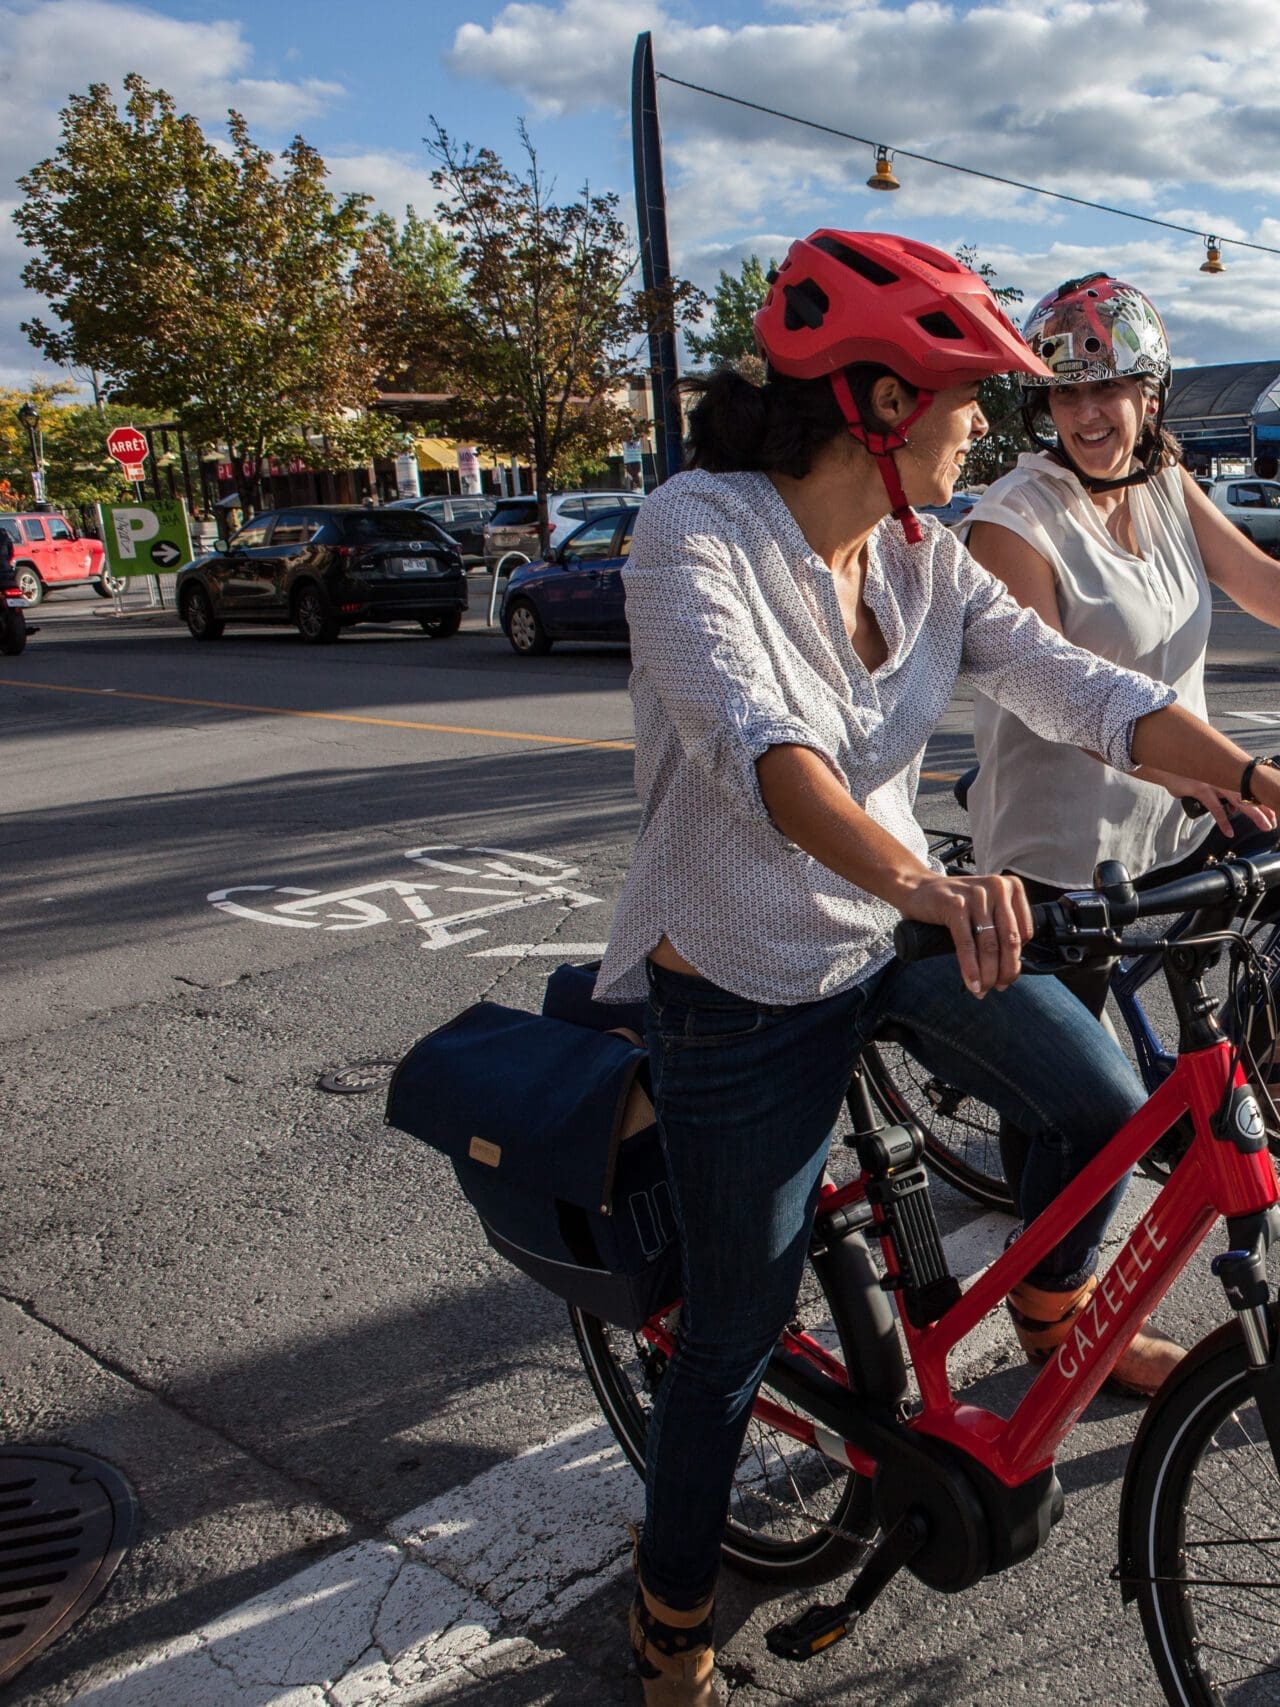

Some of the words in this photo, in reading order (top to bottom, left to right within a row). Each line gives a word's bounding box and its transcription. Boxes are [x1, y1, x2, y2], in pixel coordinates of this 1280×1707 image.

[111, 437, 146, 453] ARRÊT
[112, 507, 160, 559] P
[1057, 1212, 1168, 1379] GAZELLE
